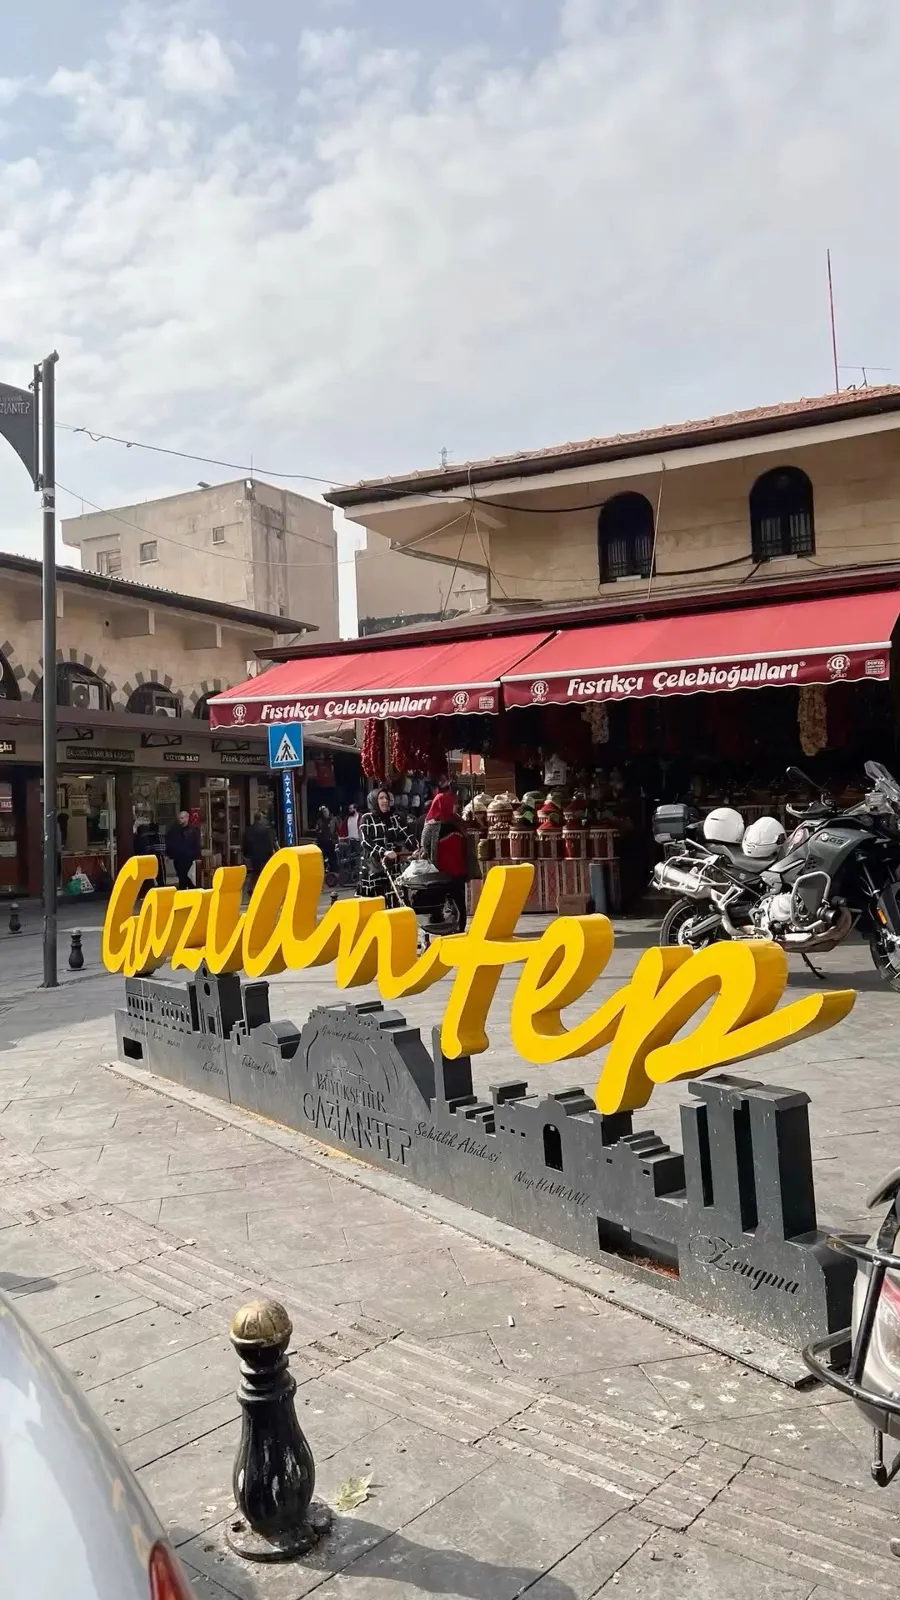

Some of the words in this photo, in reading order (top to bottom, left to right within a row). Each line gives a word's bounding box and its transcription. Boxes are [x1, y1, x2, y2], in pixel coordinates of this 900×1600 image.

[567, 674, 644, 696] Fıstıkçı
[652, 662, 799, 692] Çelebioğulları
[261, 702, 319, 719] Fıstıkçı
[324, 696, 432, 718] Çelebioğulları
[689, 1235, 801, 1295] Zeugma
